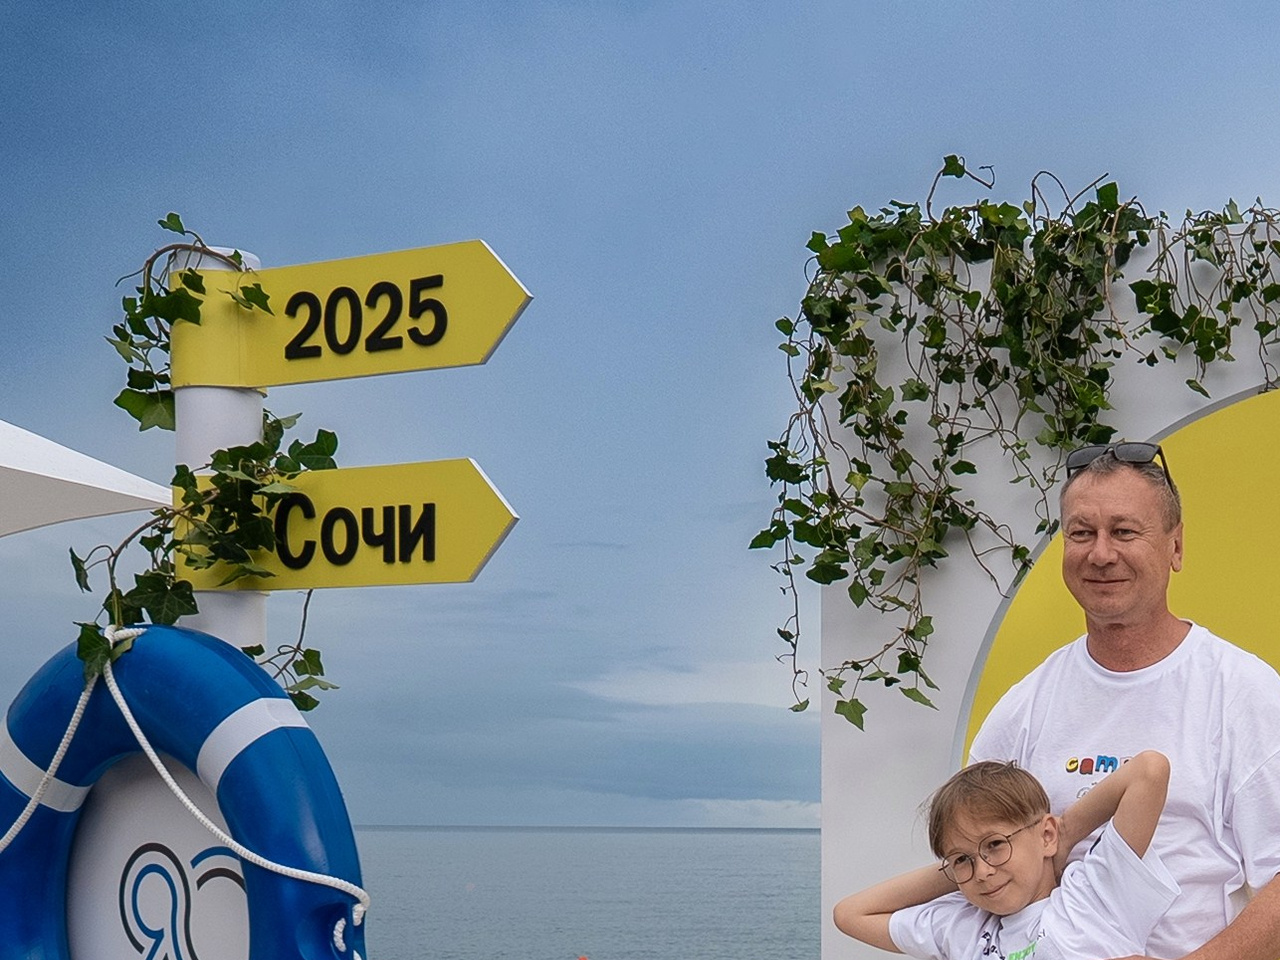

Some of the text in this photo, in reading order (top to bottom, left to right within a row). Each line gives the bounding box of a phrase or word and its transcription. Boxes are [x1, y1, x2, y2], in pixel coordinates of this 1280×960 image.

[284, 274, 448, 361] 2025
[274, 492, 436, 570] Сочи
[1065, 755, 1130, 775] cam
